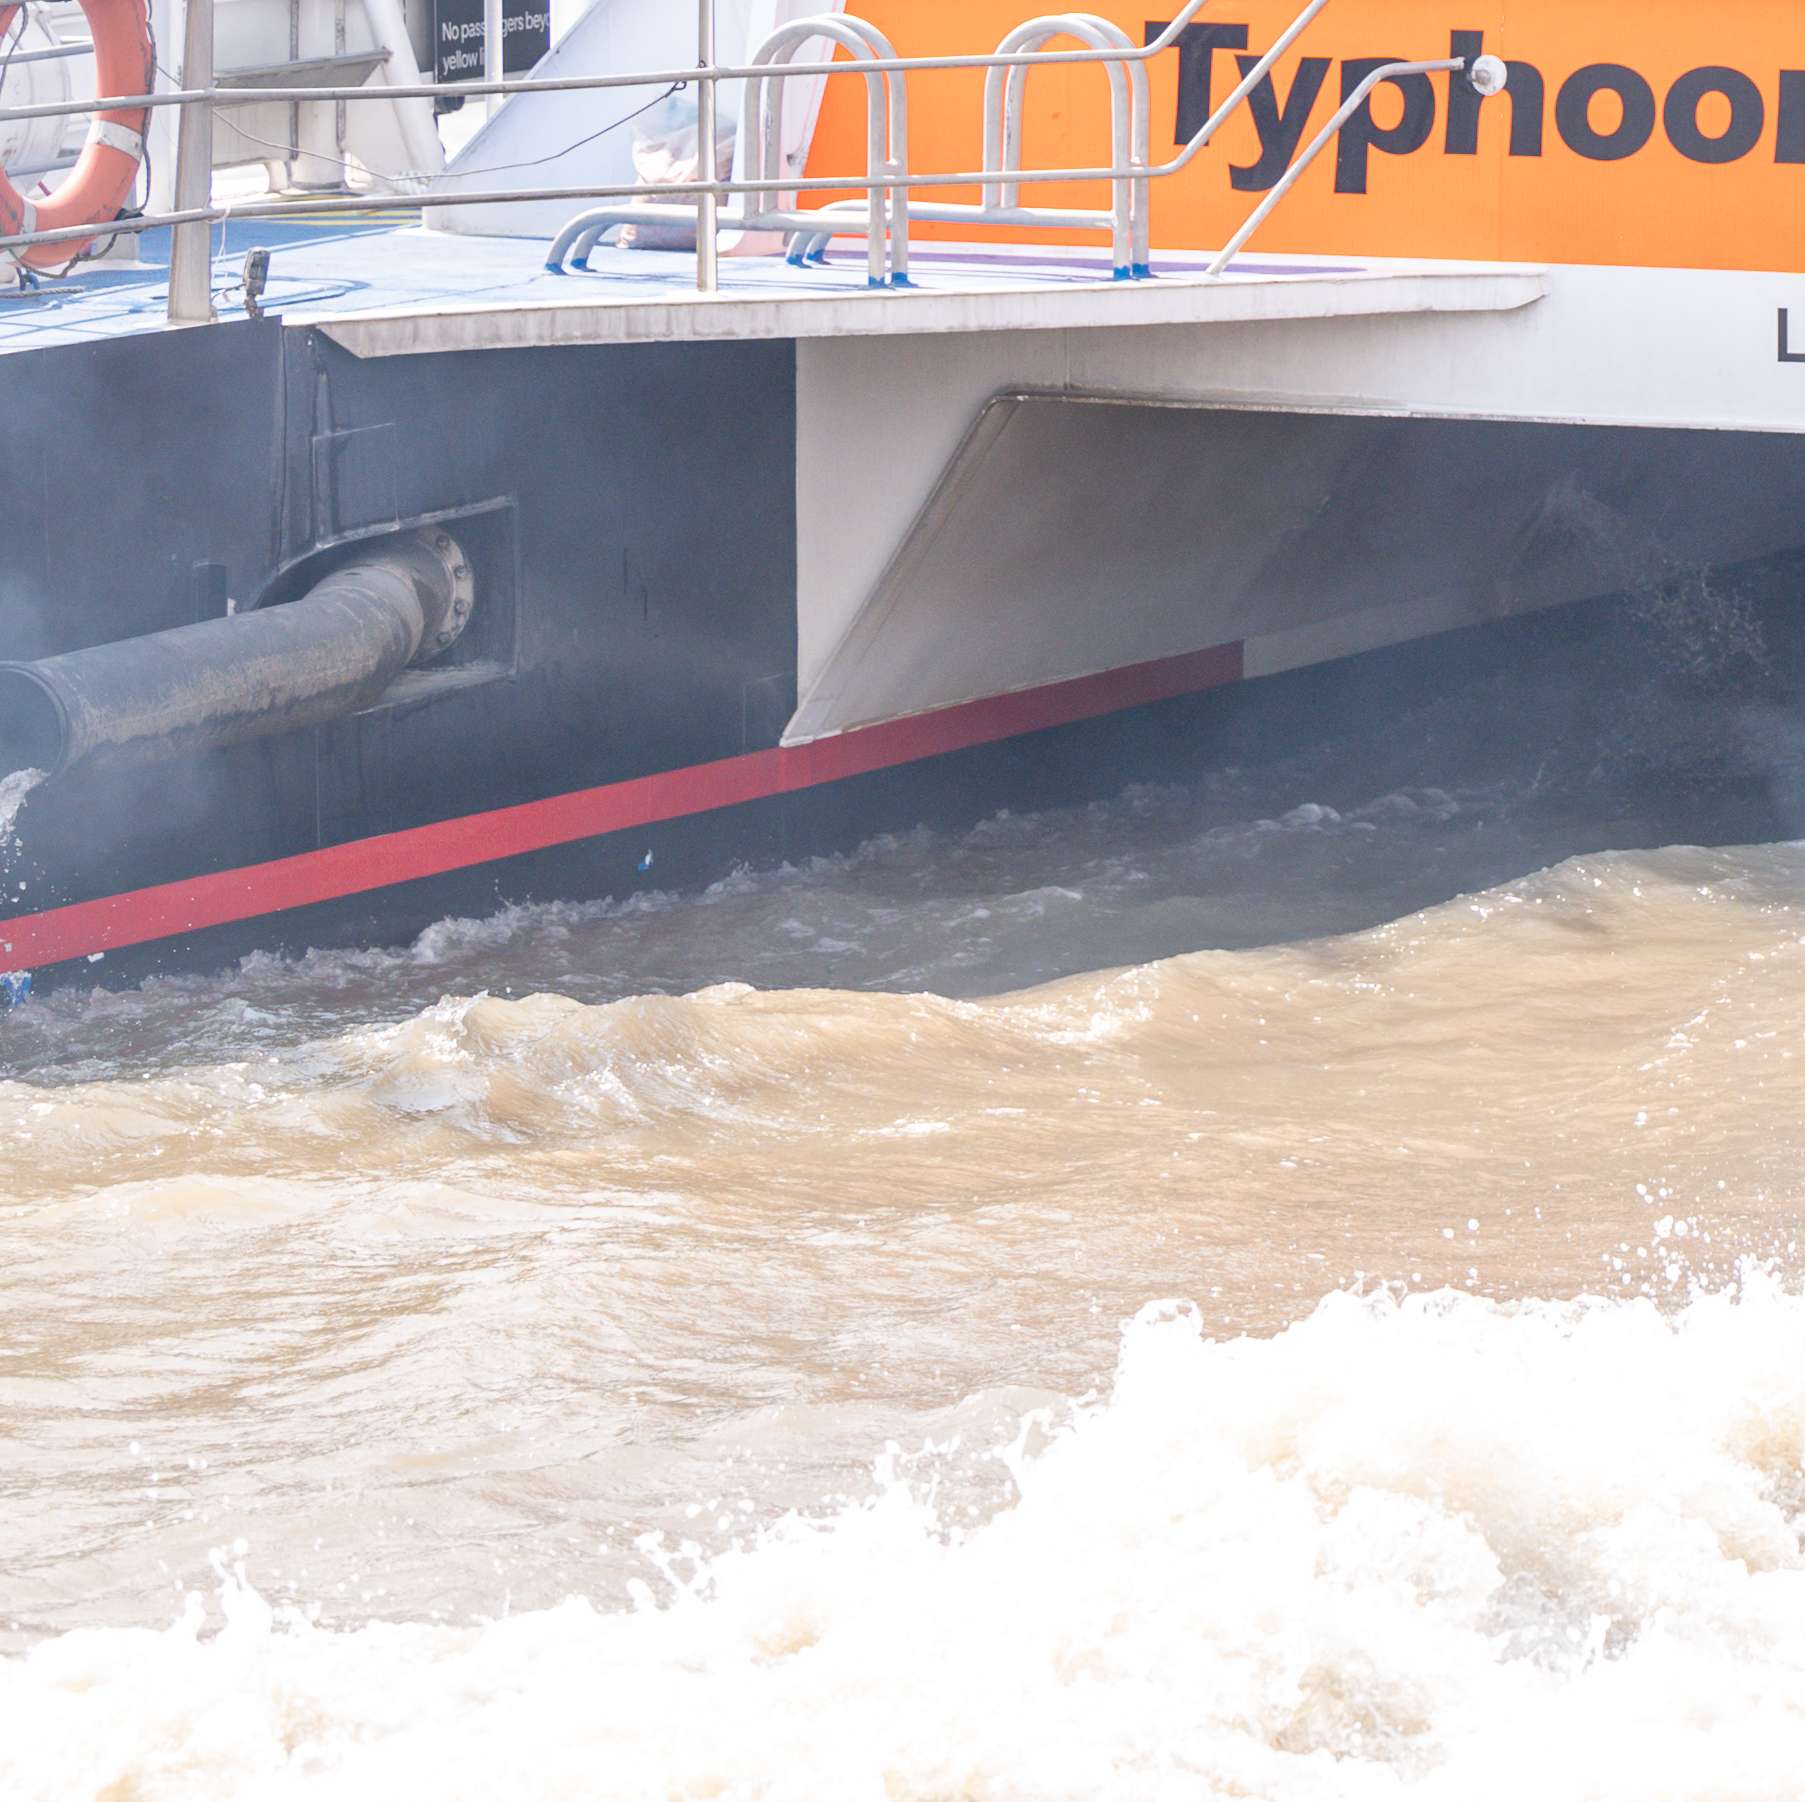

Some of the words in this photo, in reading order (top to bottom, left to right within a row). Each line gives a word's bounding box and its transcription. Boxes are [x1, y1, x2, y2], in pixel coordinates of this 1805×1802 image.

[441, 21, 460, 42] No
[460, 15, 525, 44] passgers
[442, 49, 479, 76] yellow
